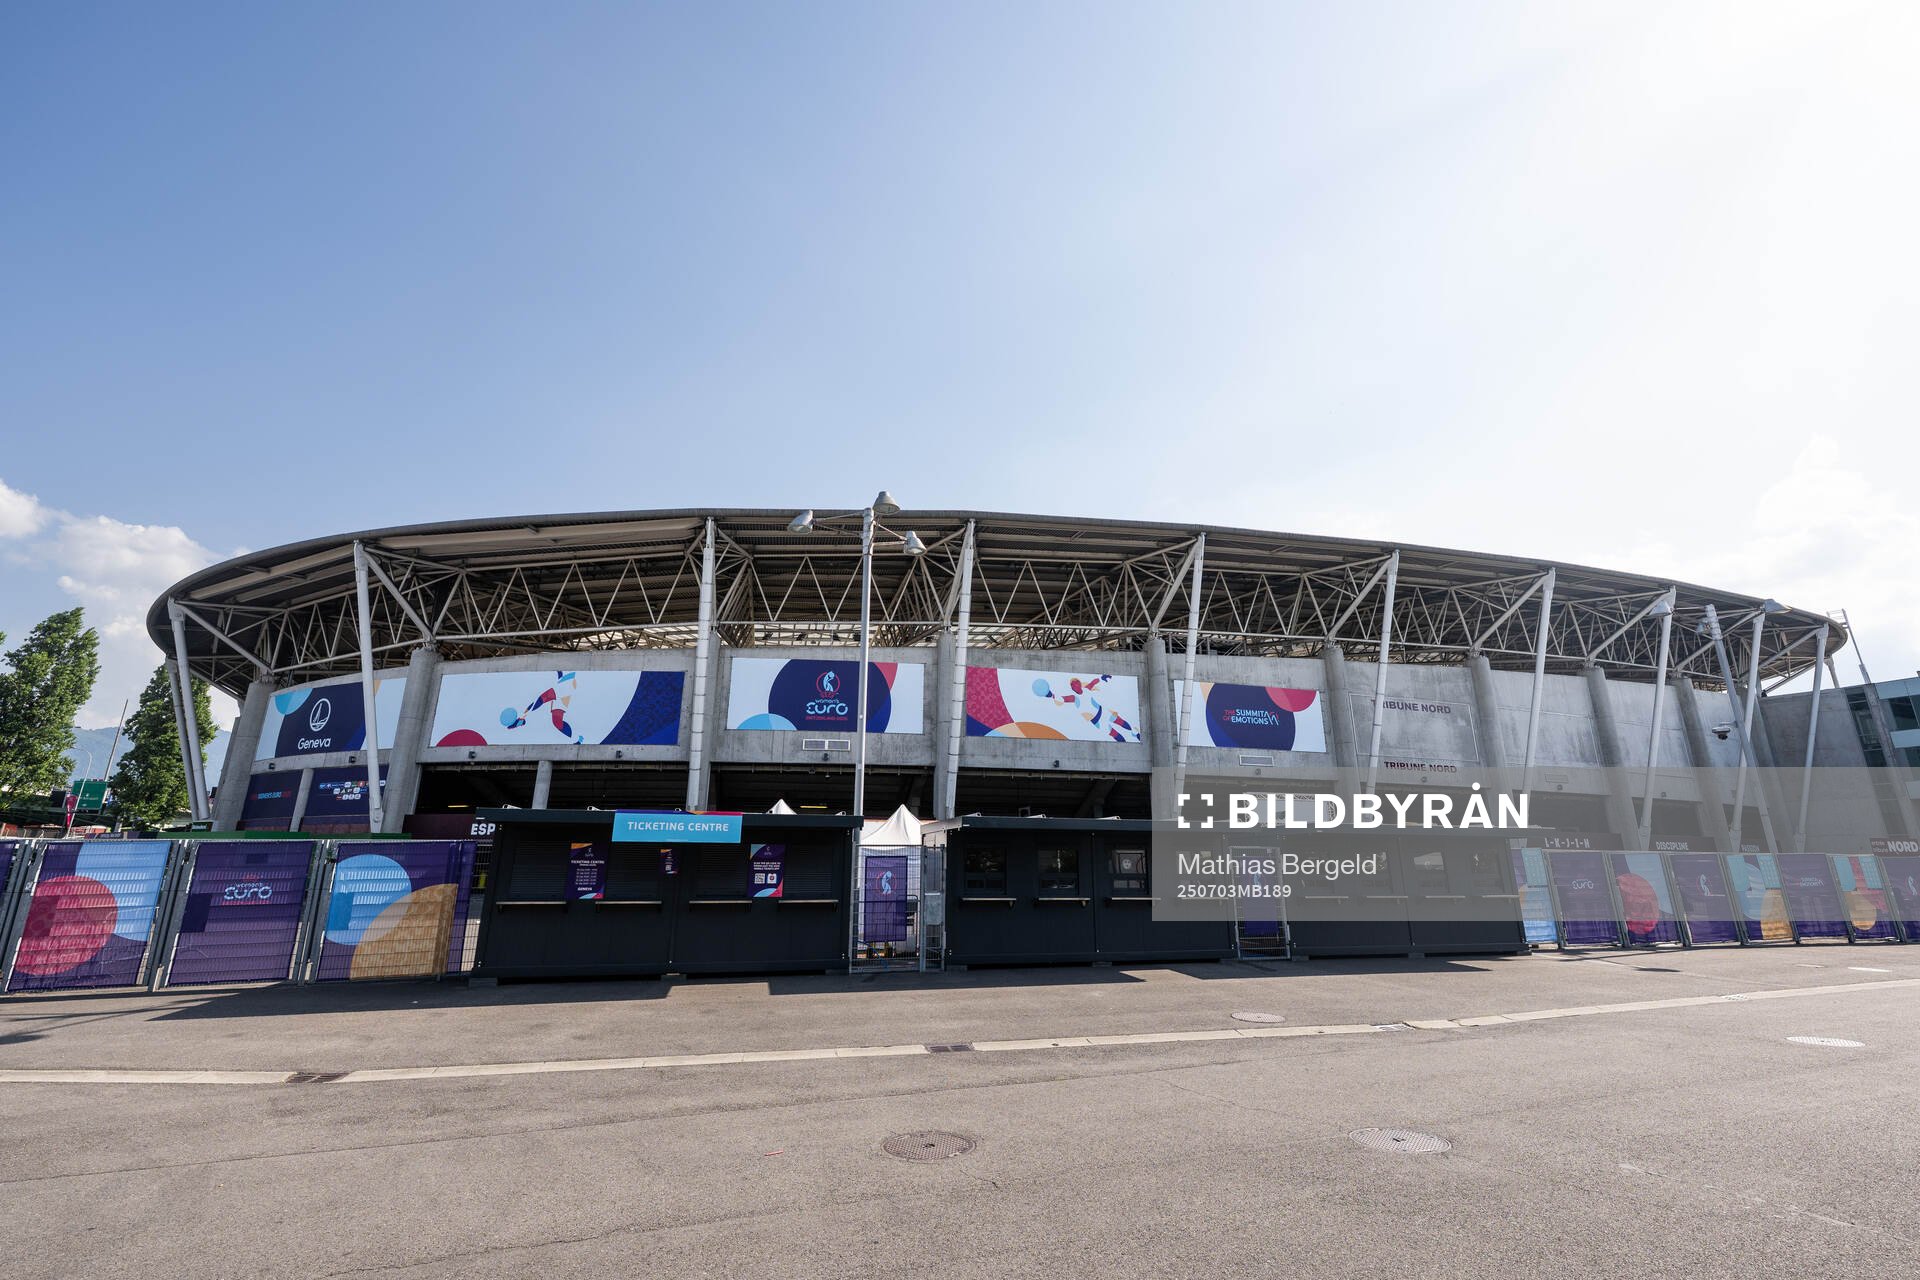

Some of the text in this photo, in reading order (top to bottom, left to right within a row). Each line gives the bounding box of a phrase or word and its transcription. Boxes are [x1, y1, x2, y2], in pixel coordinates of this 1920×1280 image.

[1421, 703, 1451, 714] NORD
[1231, 715, 1269, 725] EMOTIONS
[297, 737, 332, 750] Geneva
[1384, 761, 1458, 774] TRIBUNE NORD
[627, 821, 729, 832] TICKETING CENTRE
[1656, 841, 1689, 851] DISCIPLINE
[1887, 840, 1919, 852] NORD
